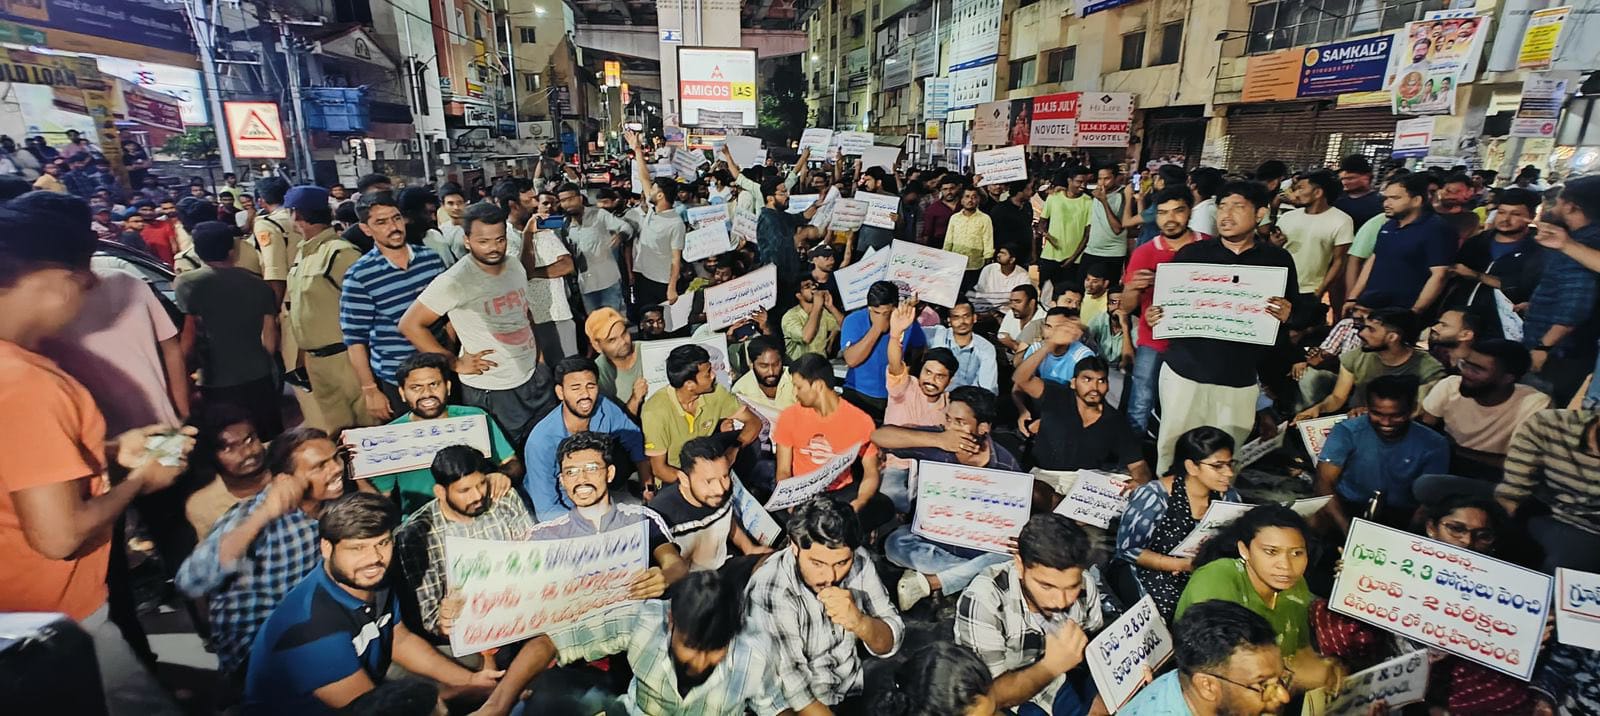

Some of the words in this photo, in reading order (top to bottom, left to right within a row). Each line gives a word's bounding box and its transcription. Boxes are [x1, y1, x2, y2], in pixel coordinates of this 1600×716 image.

[1322, 42, 1387, 62] SAMKALP
[32, 66, 79, 86] LOAN
[684, 85, 729, 96] AMIGOS
[734, 85, 752, 96] IAS
[1058, 100, 1075, 112] JULY
[1035, 124, 1070, 135] NOVOTEL
[1108, 123, 1126, 131] JULY
[1435, 569, 1494, 603] పోస్టులు
[1497, 587, 1542, 615] పెంచి
[1422, 596, 1440, 611] 2
[1443, 601, 1519, 637] పరీక్షలు
